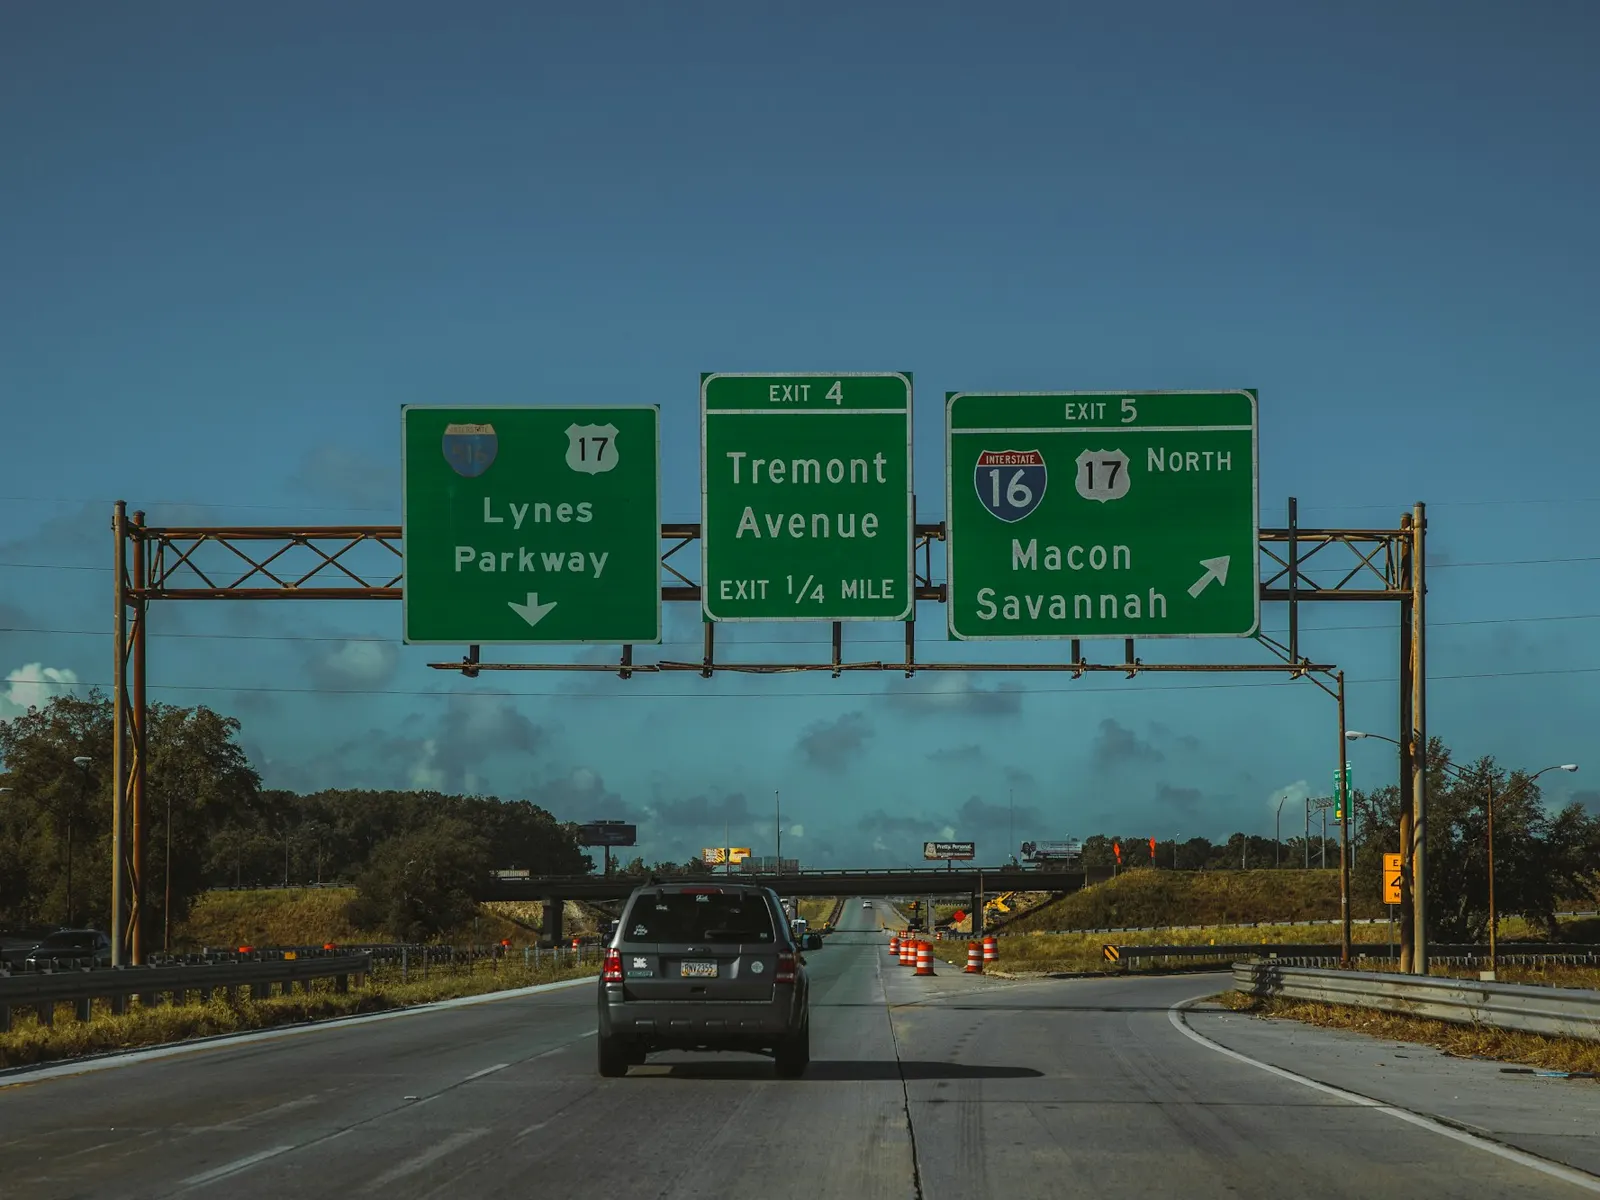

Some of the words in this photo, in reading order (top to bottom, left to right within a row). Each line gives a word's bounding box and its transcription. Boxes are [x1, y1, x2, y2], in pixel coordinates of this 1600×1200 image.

[769, 384, 811, 402] EXIT
[824, 380, 844, 406] 4
[1065, 402, 1107, 420] EXIT
[1120, 398, 1138, 423] 5
[578, 437, 609, 462] 17
[985, 454, 1035, 465] INTERSTATE
[726, 451, 887, 484] Tremont
[1085, 460, 1122, 490] 17
[989, 468, 1033, 508] 16
[483, 496, 593, 530] Lynes
[735, 506, 879, 539] Avenue
[455, 545, 609, 579] Parkway
[1011, 538, 1131, 571] Macon
[720, 579, 770, 600] EXIT
[841, 578, 895, 600] MILE
[975, 587, 1167, 621] Savannah
